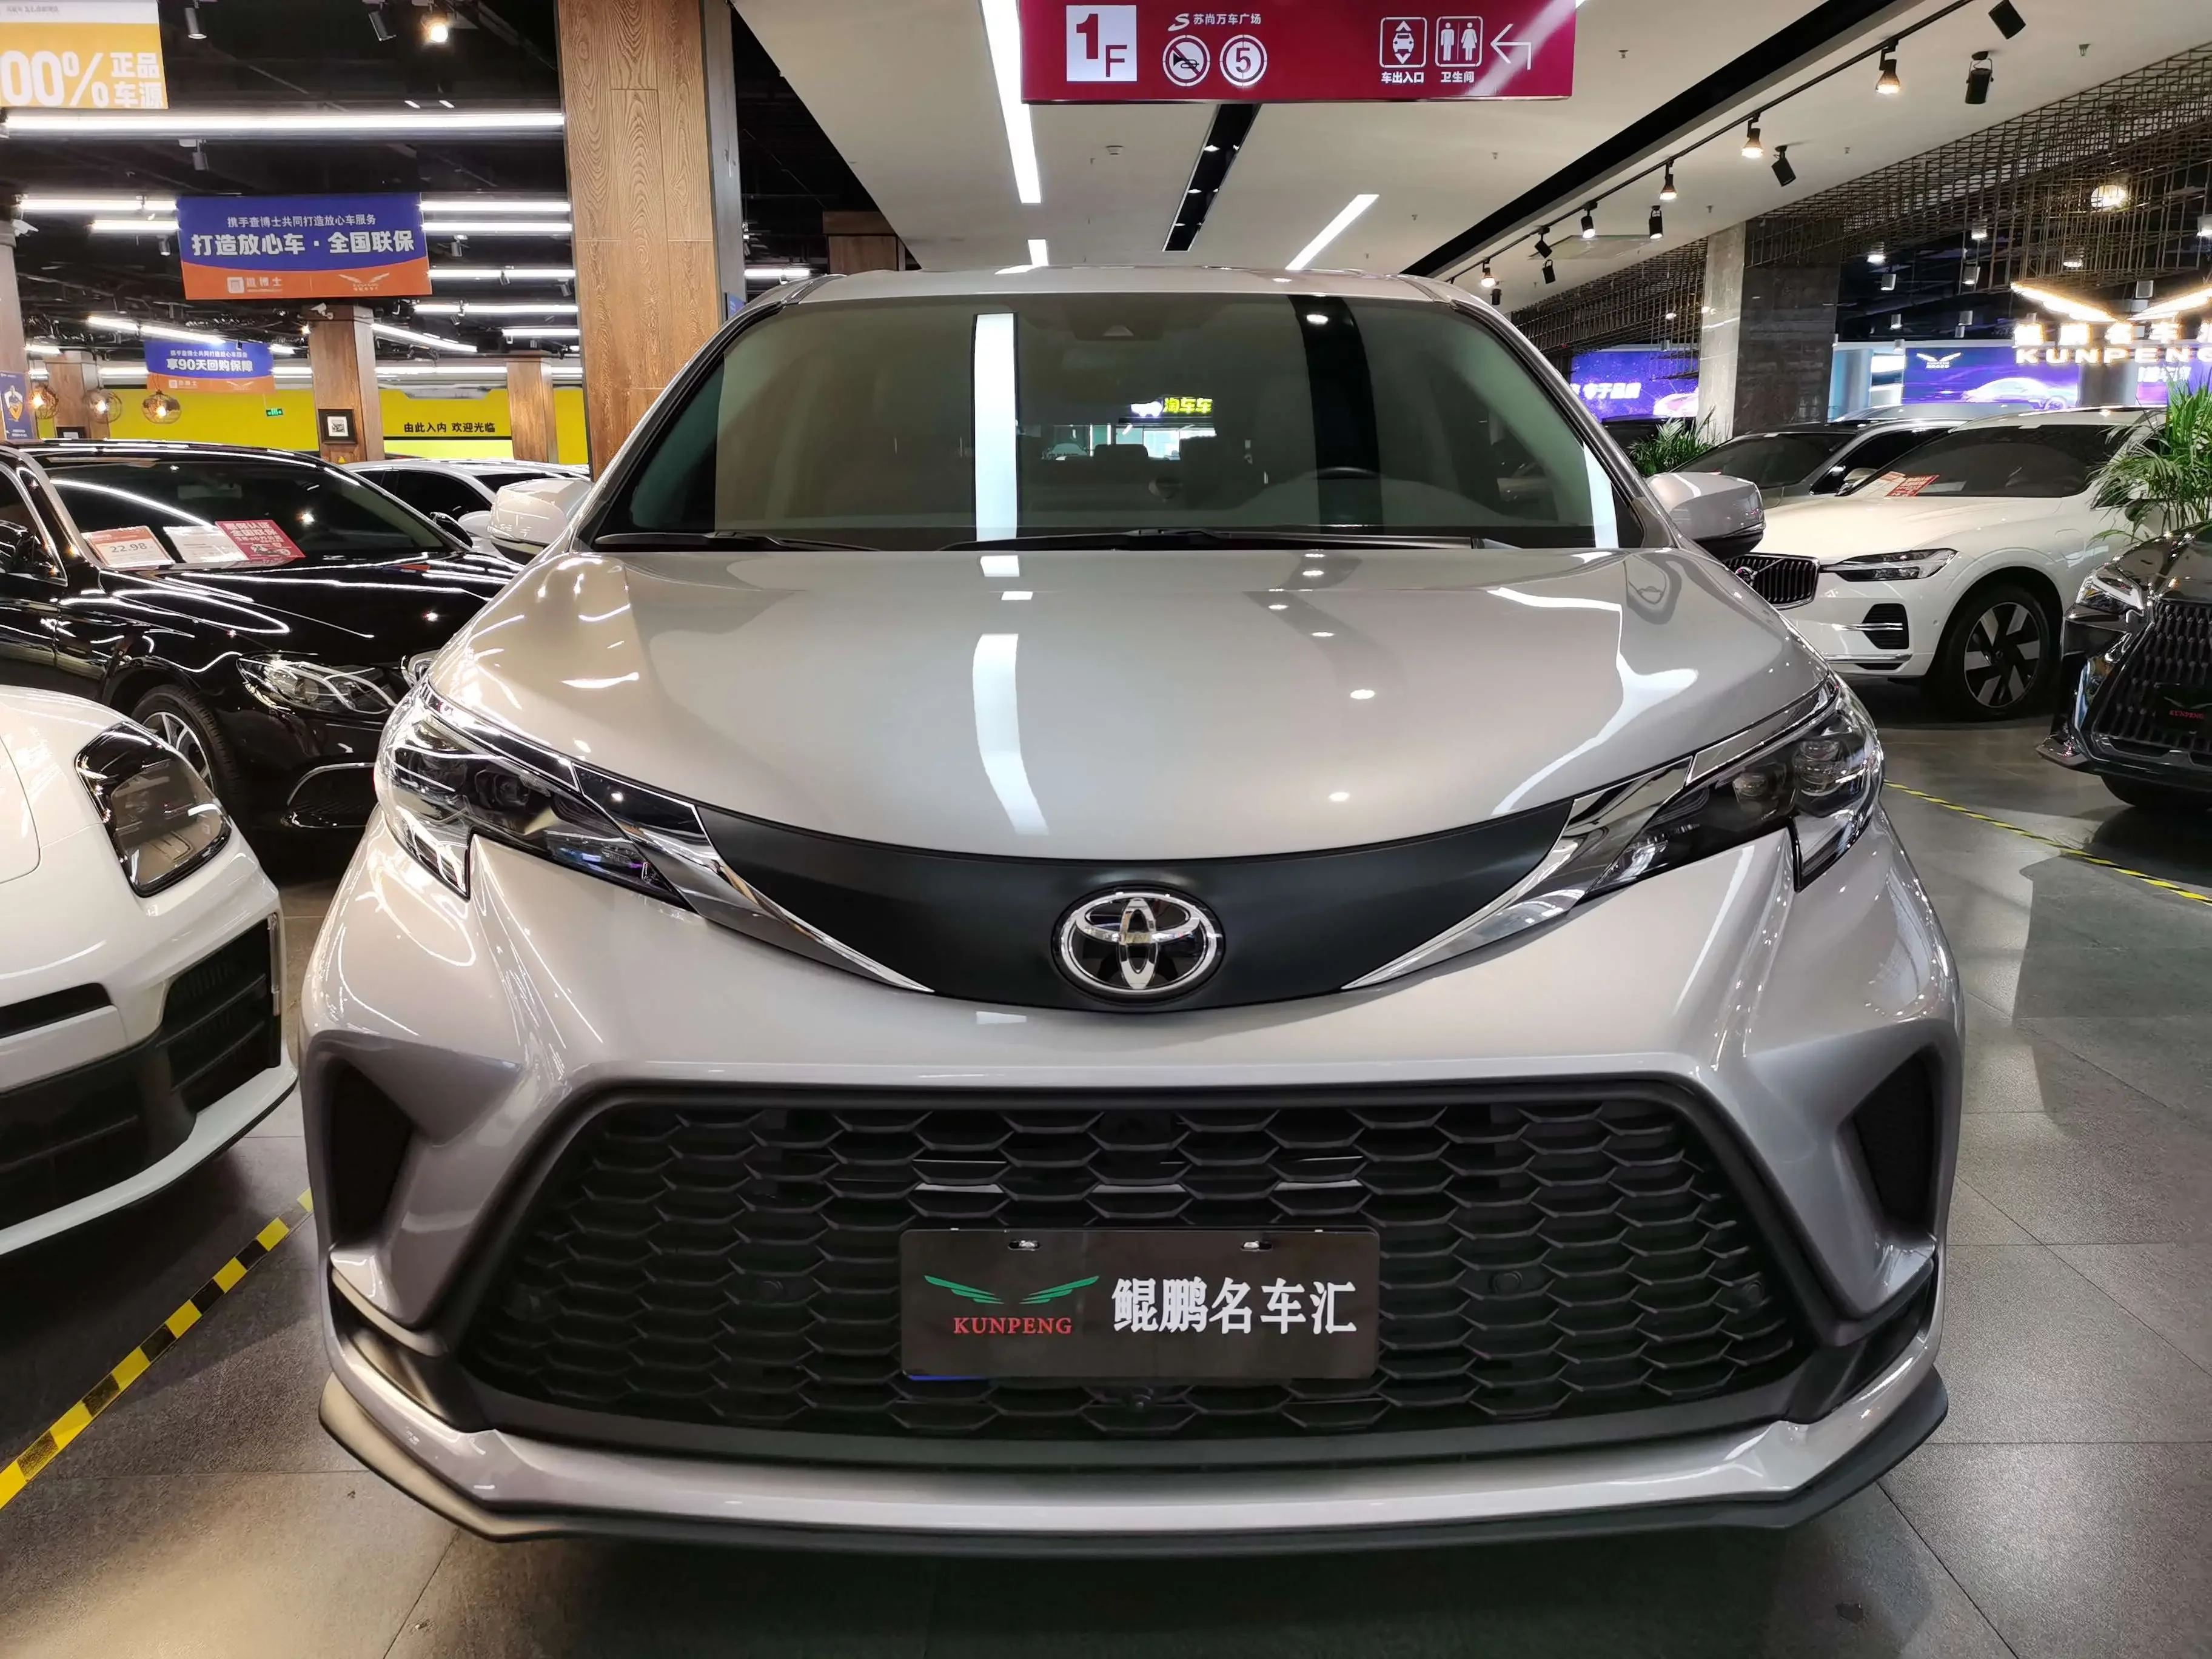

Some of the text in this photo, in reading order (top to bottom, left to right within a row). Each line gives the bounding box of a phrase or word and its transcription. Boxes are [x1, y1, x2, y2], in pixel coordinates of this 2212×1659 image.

[1193, 13, 1262, 25] 苏尚万车广场
[110, 52, 160, 78] 正品
[1235, 47, 1252, 73] 5
[1381, 71, 1425, 84] 车出入口
[1440, 71, 1475, 83] 卫生间
[113, 81, 163, 109] 车源
[1163, 397, 1213, 414] 淘车车
[404, 422, 496, 433] 由此入内 欢迎光临
[110, 543, 147, 553] 22.98
[1111, 1276, 1358, 1335] 鲲鹏名车汇
[953, 1317, 1073, 1335] KUNPENG
